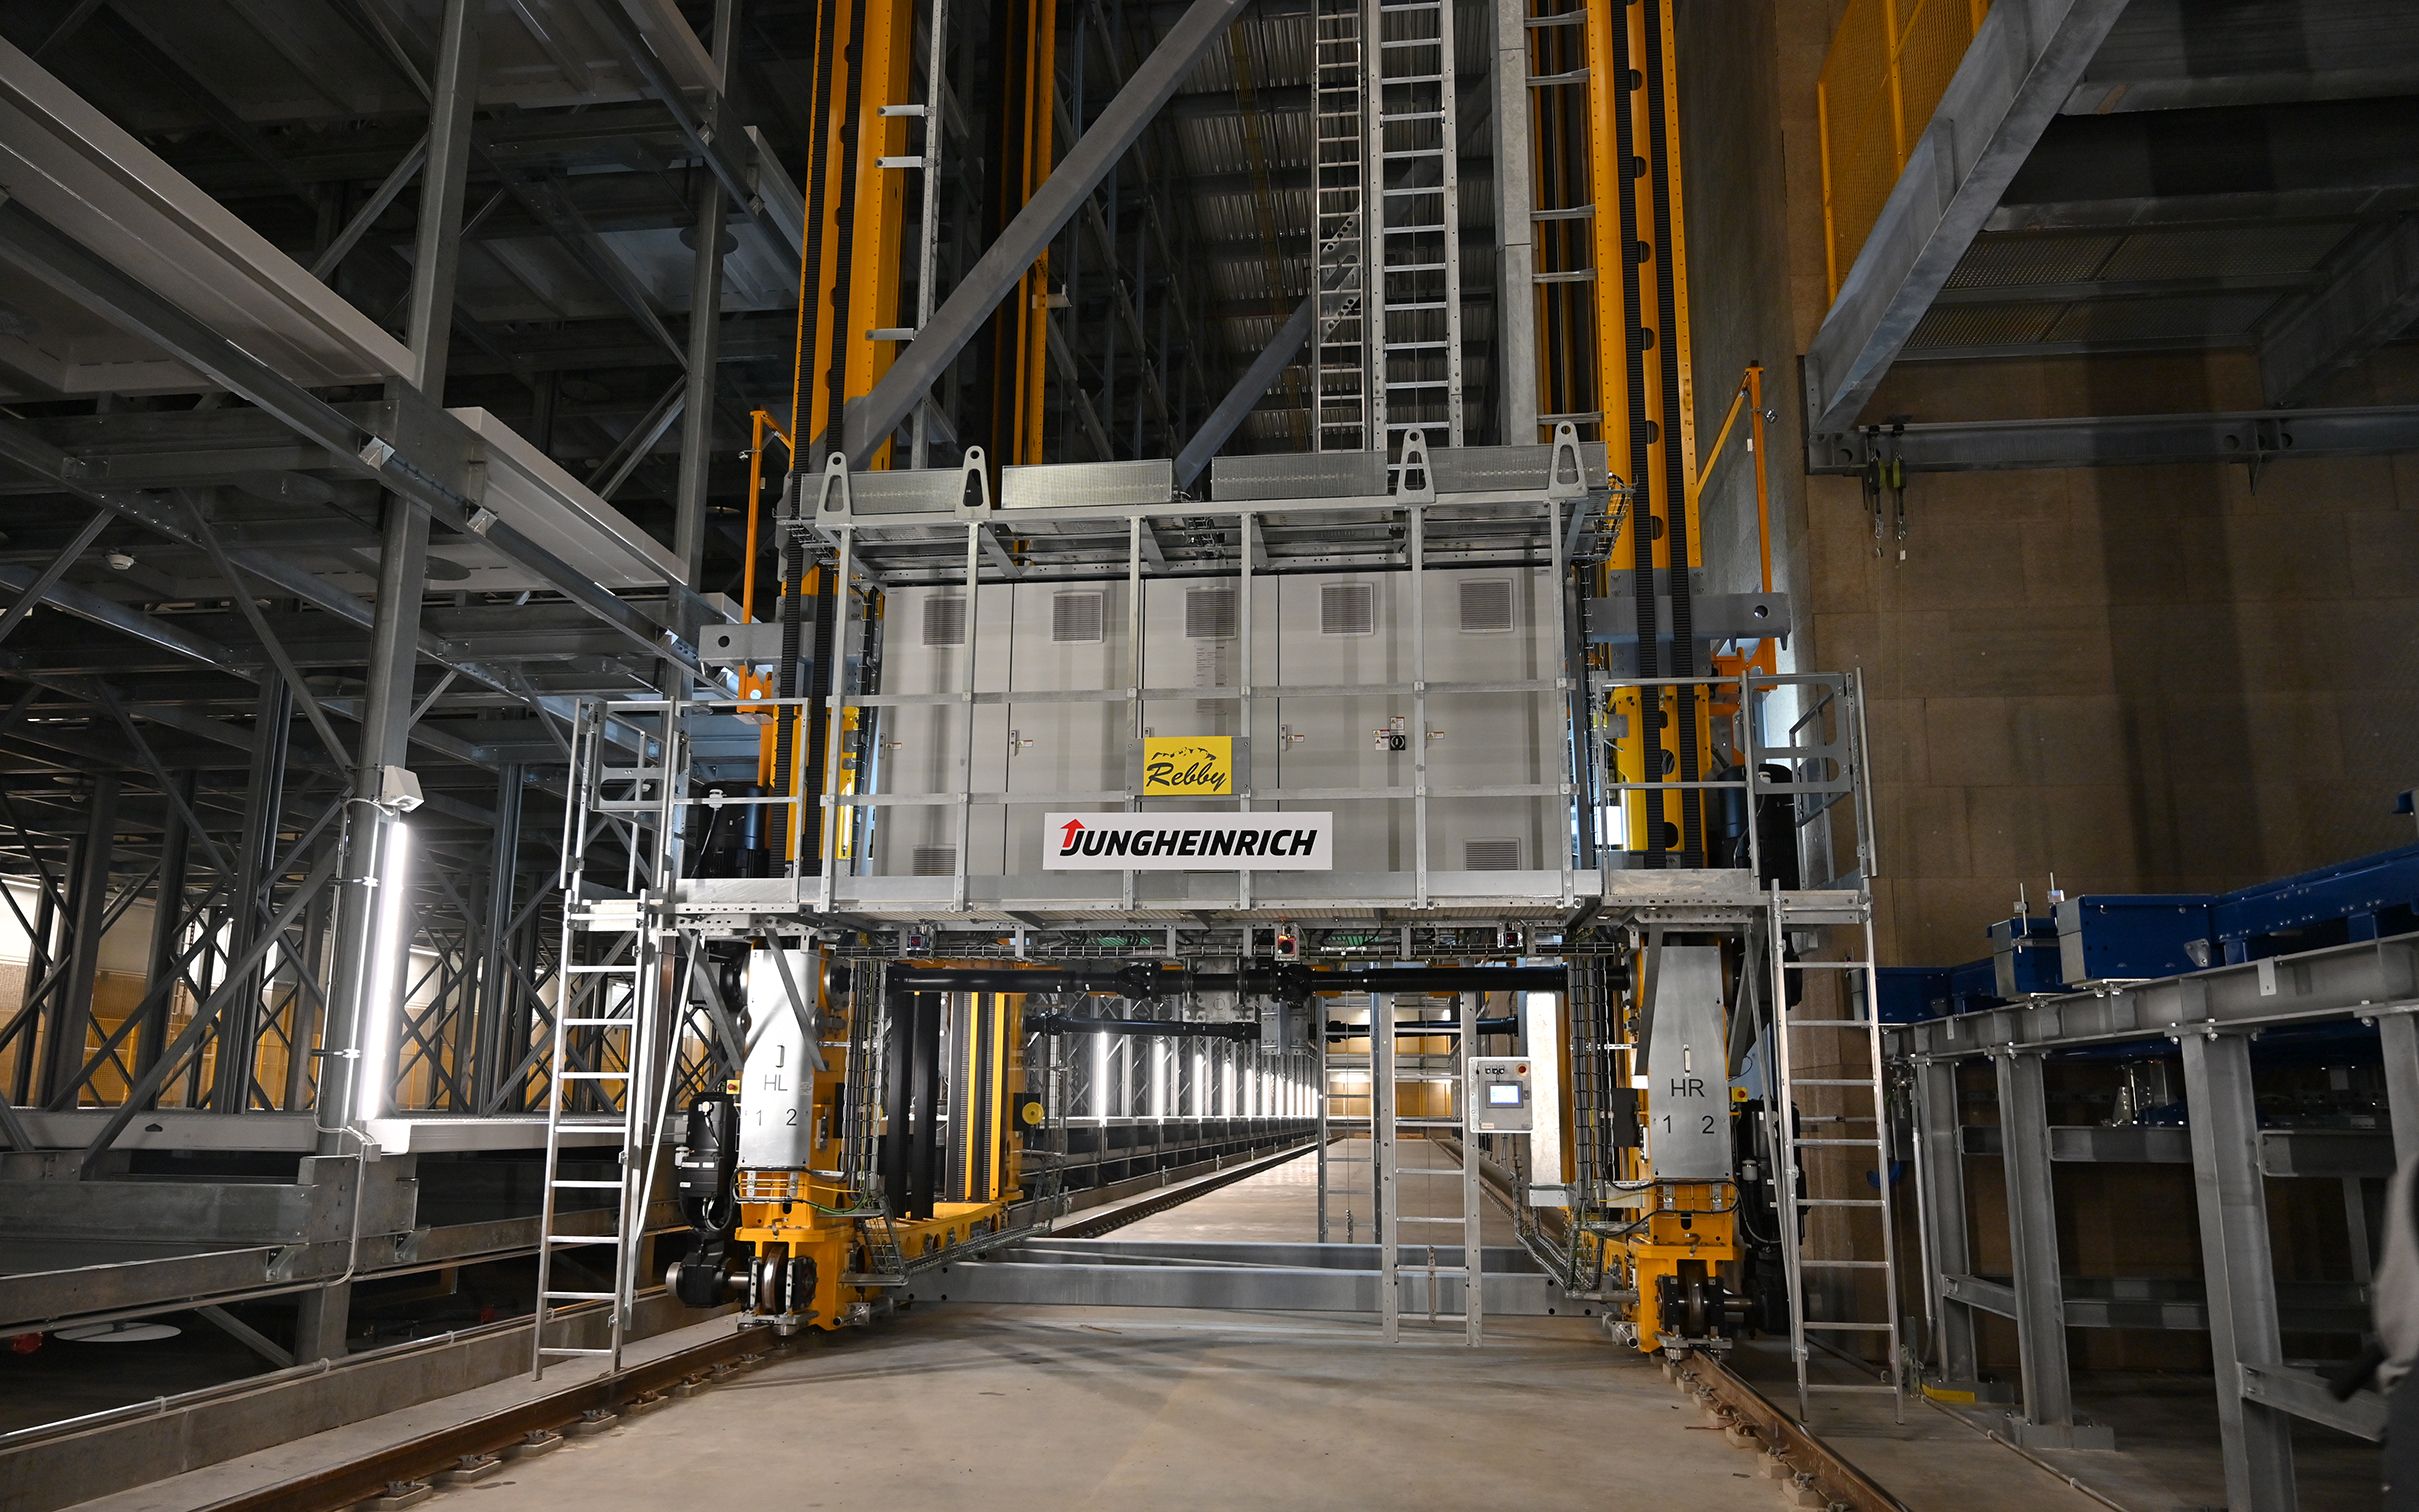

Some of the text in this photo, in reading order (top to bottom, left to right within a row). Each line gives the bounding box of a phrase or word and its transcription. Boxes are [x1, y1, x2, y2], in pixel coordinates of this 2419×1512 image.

[1146, 762, 1226, 792] Rebby
[1059, 829, 1318, 856] JUNGHEINRICH
[763, 1074, 788, 1091] HL
[1670, 1078, 1705, 1097] HR
[756, 1108, 798, 1126] 1 2
[1663, 1114, 1715, 1134] 1 2
